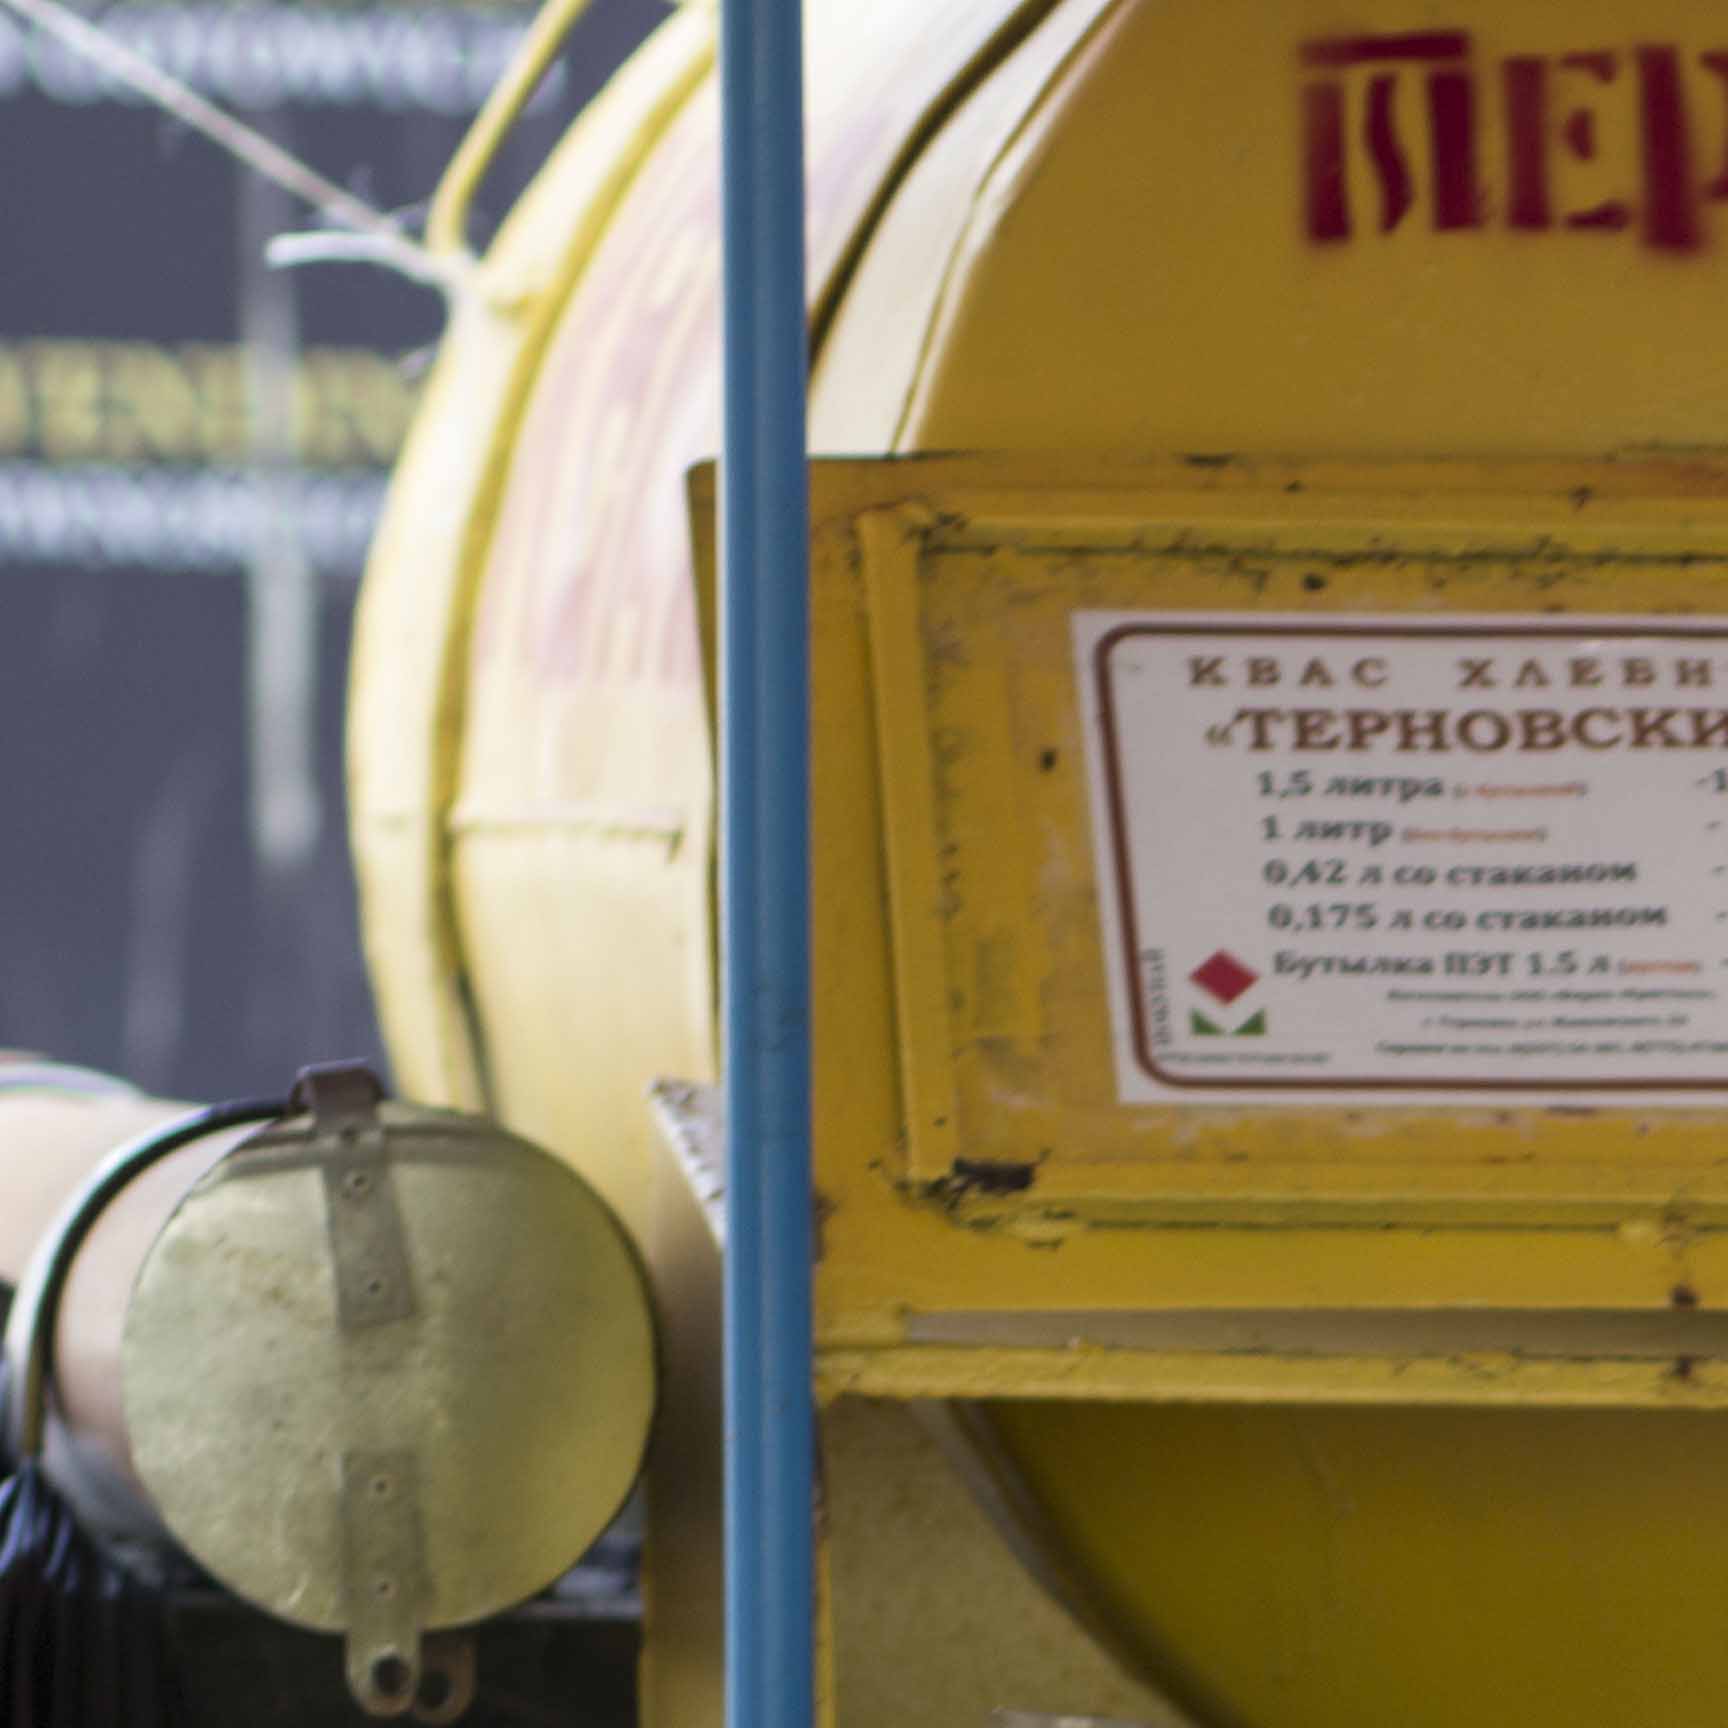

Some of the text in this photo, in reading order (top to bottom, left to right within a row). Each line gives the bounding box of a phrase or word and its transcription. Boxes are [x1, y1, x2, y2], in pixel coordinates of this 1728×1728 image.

[1186, 655, 1389, 688] КВАС
[1257, 769, 1313, 799] 1,5
[1322, 774, 1444, 803] литра
[1261, 815, 1281, 840] 1
[1294, 818, 1393, 847] литр
[1262, 858, 1346, 887] 0,42
[1393, 864, 1437, 886] со
[1446, 862, 1636, 886] стаканом
[1267, 902, 1379, 930] 0,175
[1423, 908, 1467, 931] со
[1476, 906, 1668, 930] стаканом
[1273, 950, 1434, 982] Бутылка
[1443, 951, 1513, 976] ПЭТ
